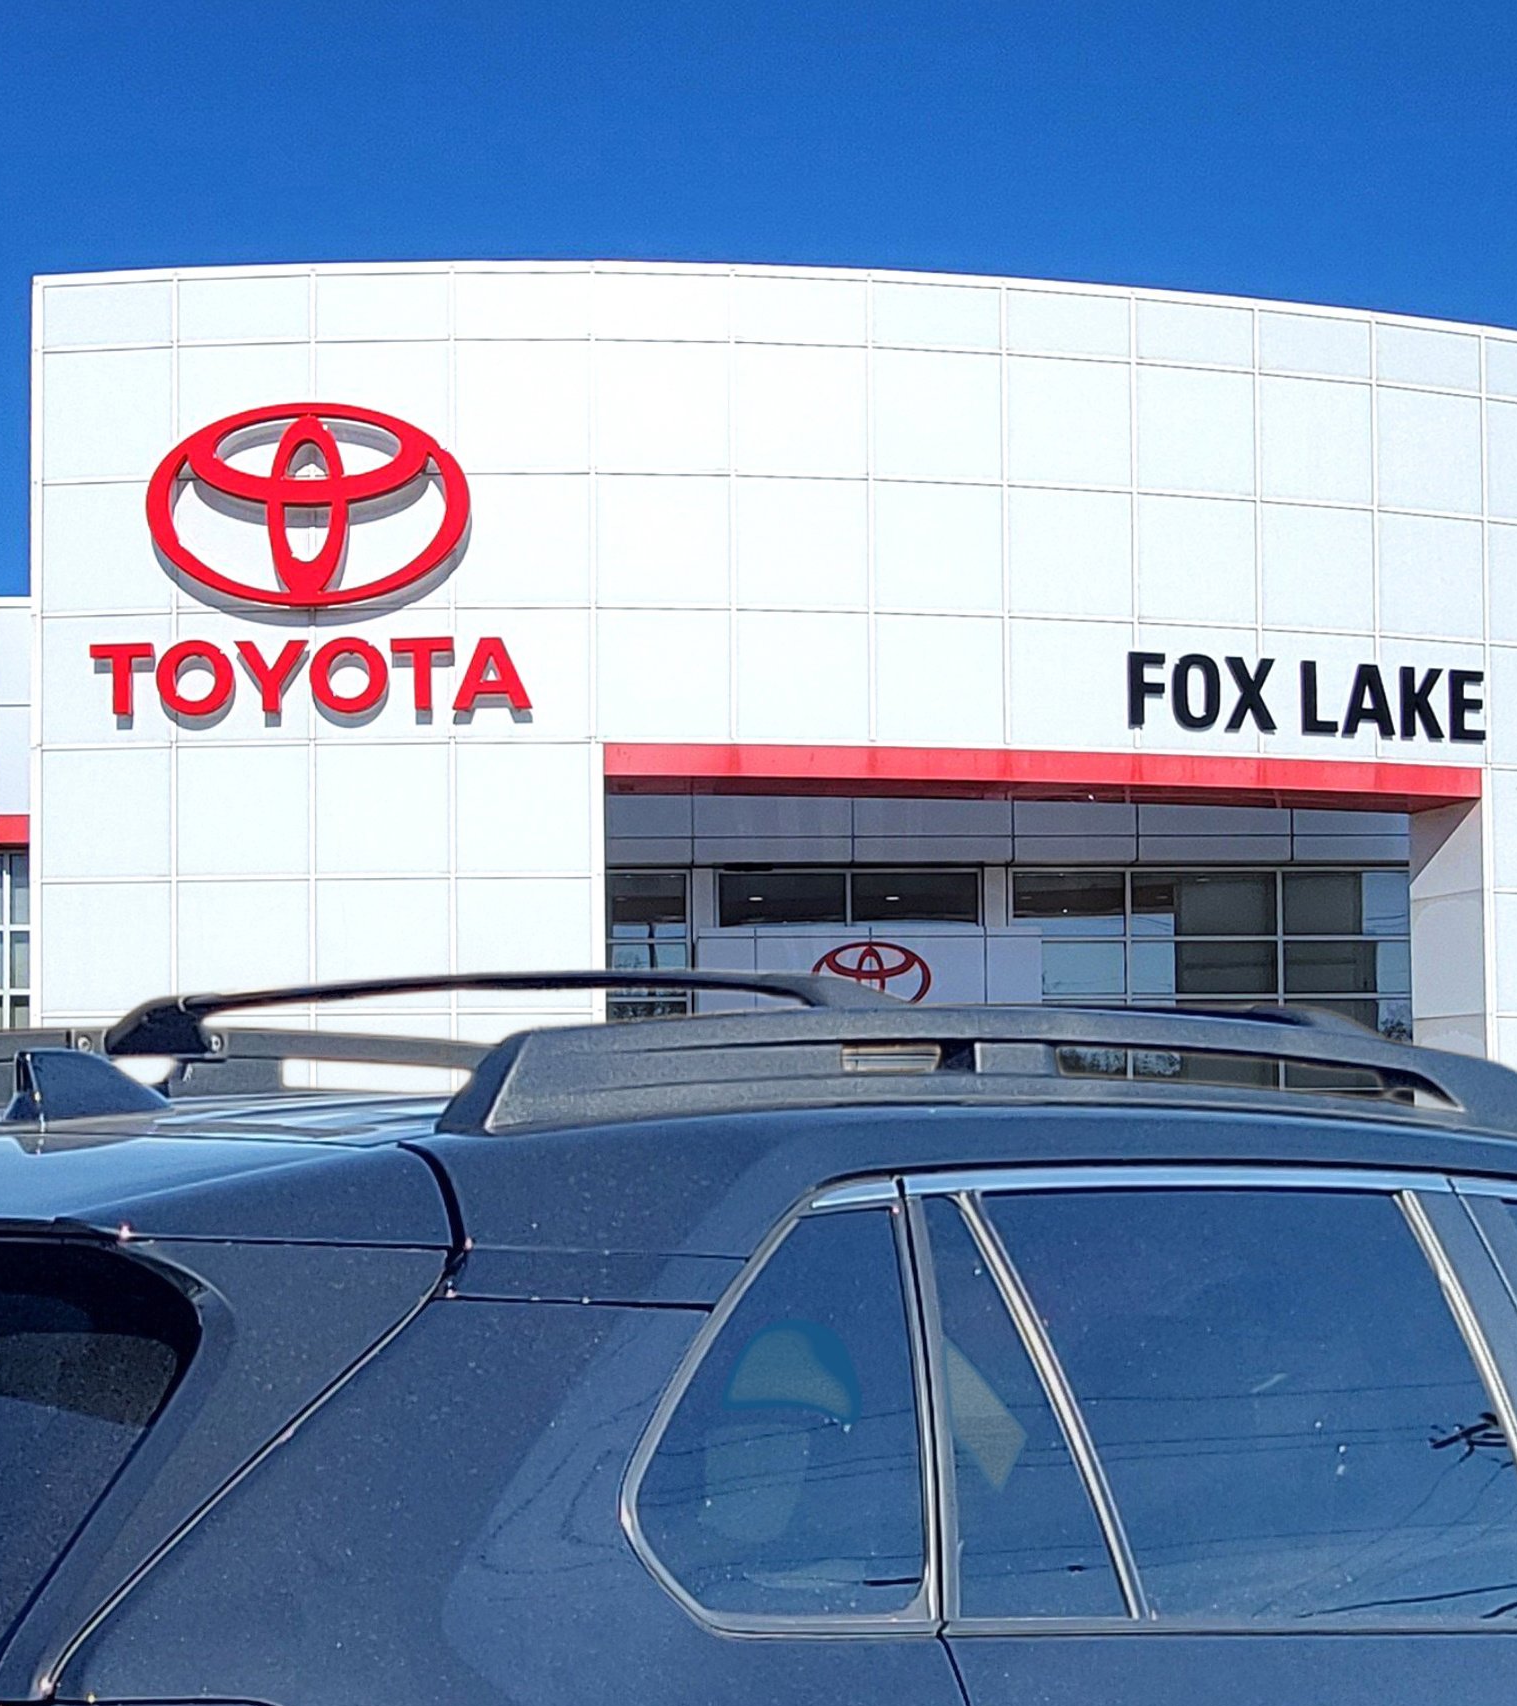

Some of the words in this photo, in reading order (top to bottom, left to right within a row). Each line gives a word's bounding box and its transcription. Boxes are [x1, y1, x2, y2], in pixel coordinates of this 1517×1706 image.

[89, 636, 533, 718] TOYOTA
[1127, 651, 1277, 733] FOX
[1299, 660, 1486, 741] LAKE
